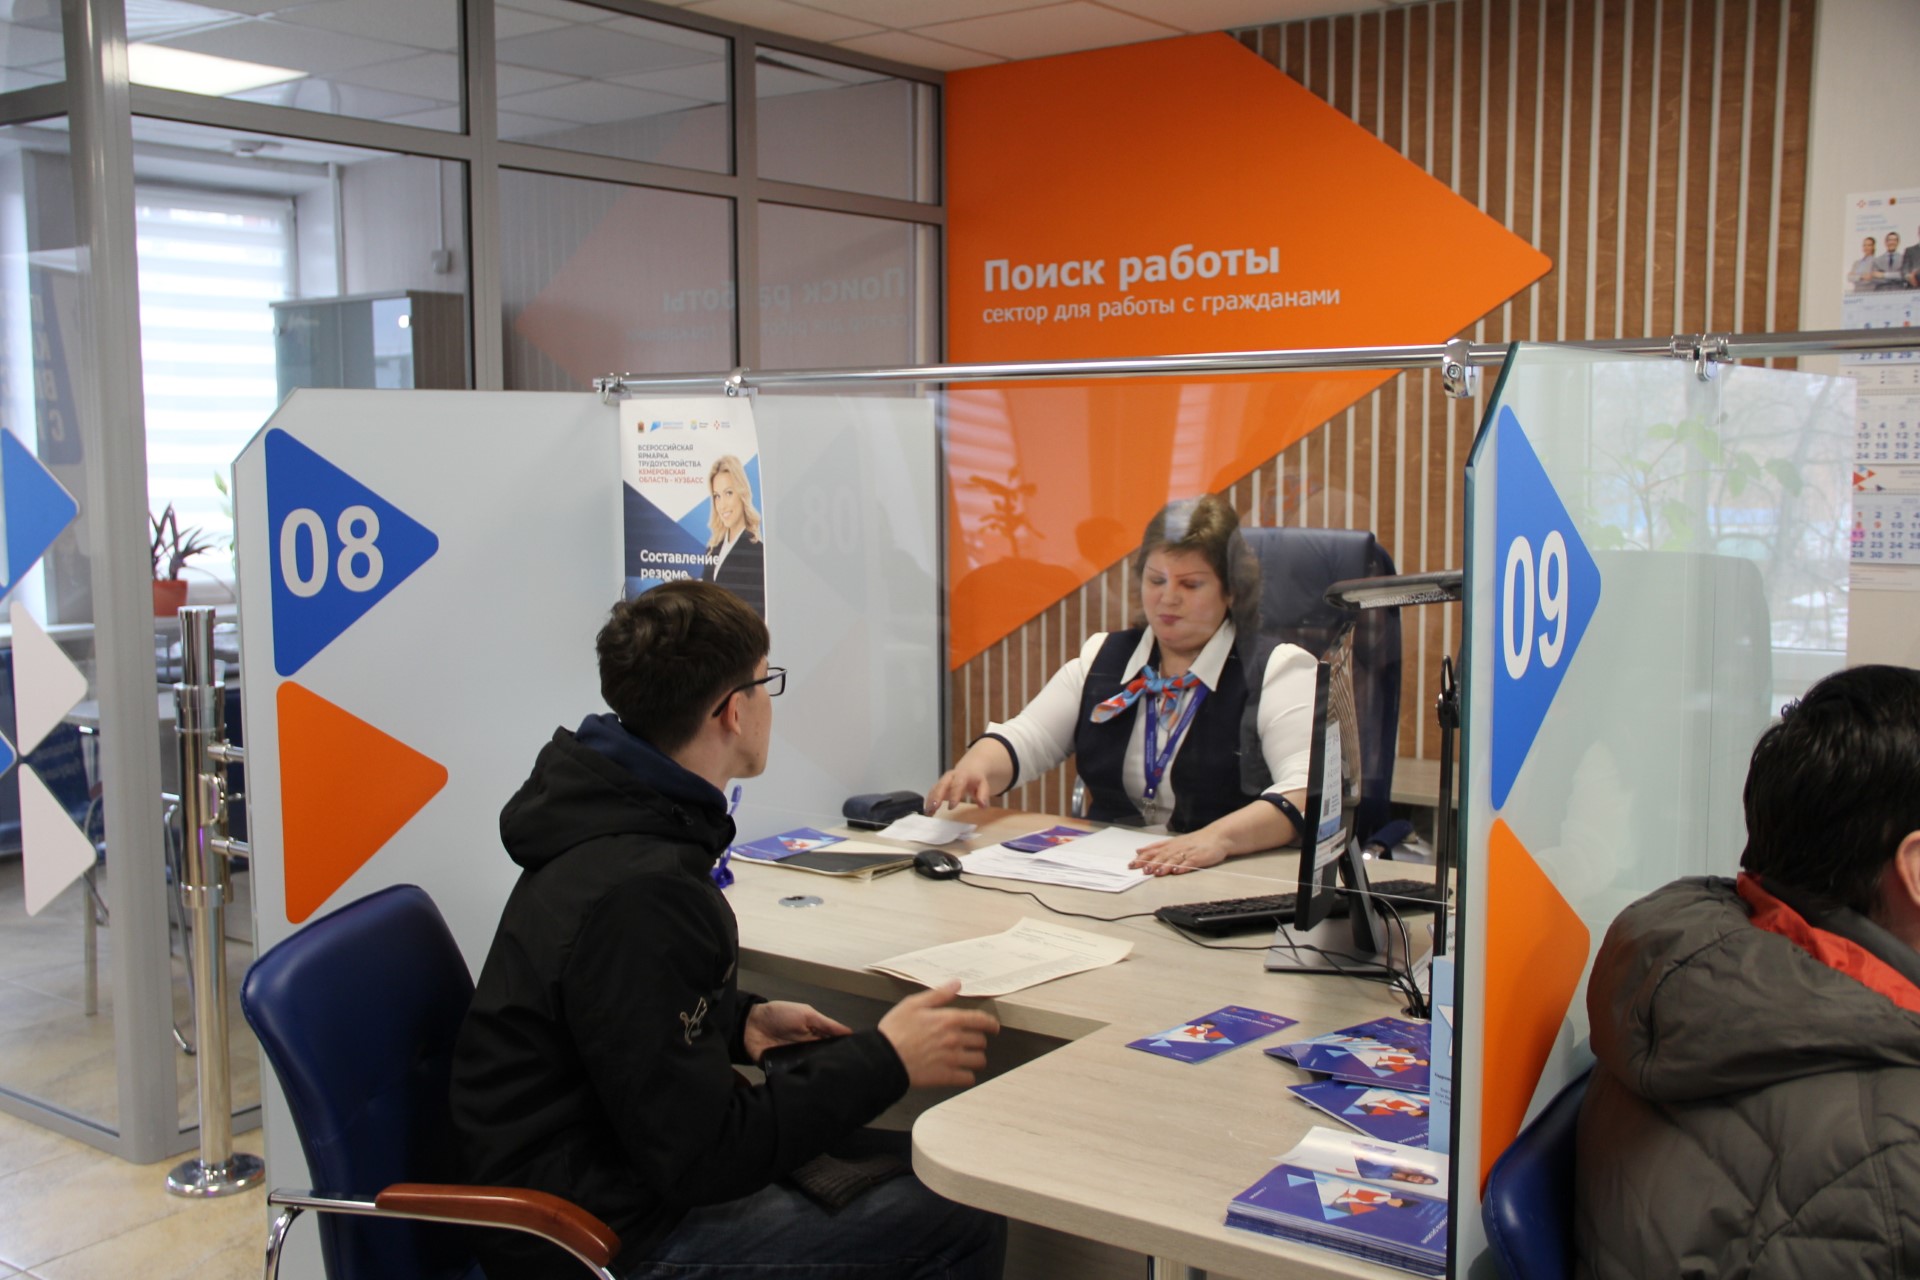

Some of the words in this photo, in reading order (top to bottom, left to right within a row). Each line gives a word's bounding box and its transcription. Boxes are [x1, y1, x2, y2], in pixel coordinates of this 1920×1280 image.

[984, 258, 1105, 292] Поиск
[1119, 243, 1280, 291] работы
[982, 305, 1048, 325] сектор
[1053, 303, 1091, 322] для
[1098, 295, 1175, 322] работы
[1182, 297, 1195, 313] с
[1201, 289, 1340, 316] гражданами
[638, 443, 693, 451] ВСЕРОССИЙСКАЯ
[639, 459, 701, 467] ТРУДОУСТРОЙСТВА
[675, 476, 703, 484] КУЗБАСС
[280, 505, 384, 598] 08
[640, 549, 719, 566] Составление
[641, 567, 689, 581] резюме
[1503, 530, 1568, 679] 09
